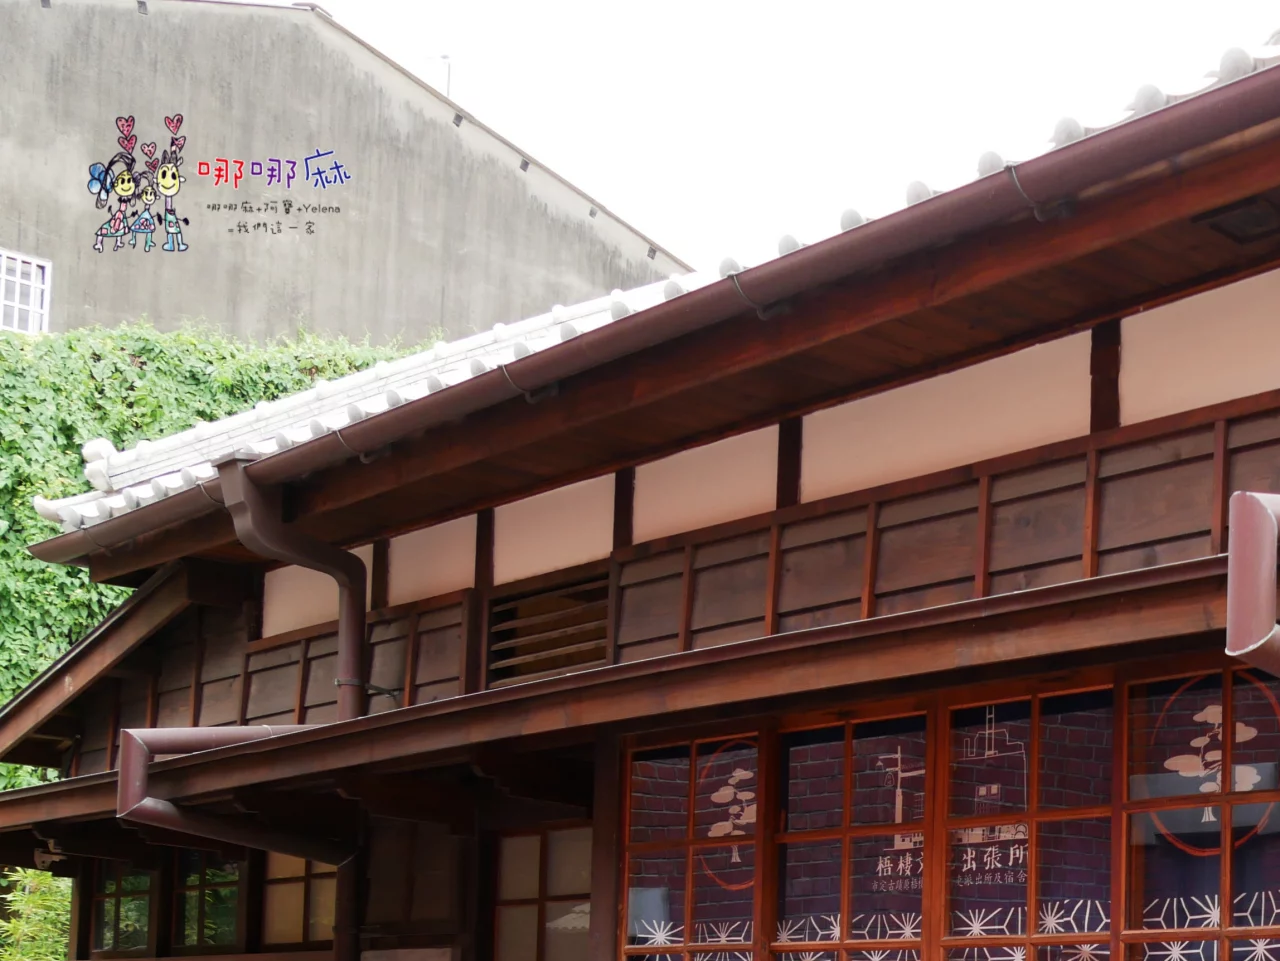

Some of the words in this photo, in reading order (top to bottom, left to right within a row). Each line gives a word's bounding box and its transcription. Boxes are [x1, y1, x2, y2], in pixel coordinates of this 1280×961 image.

[876, 843, 1029, 877] 梧棲出張所
